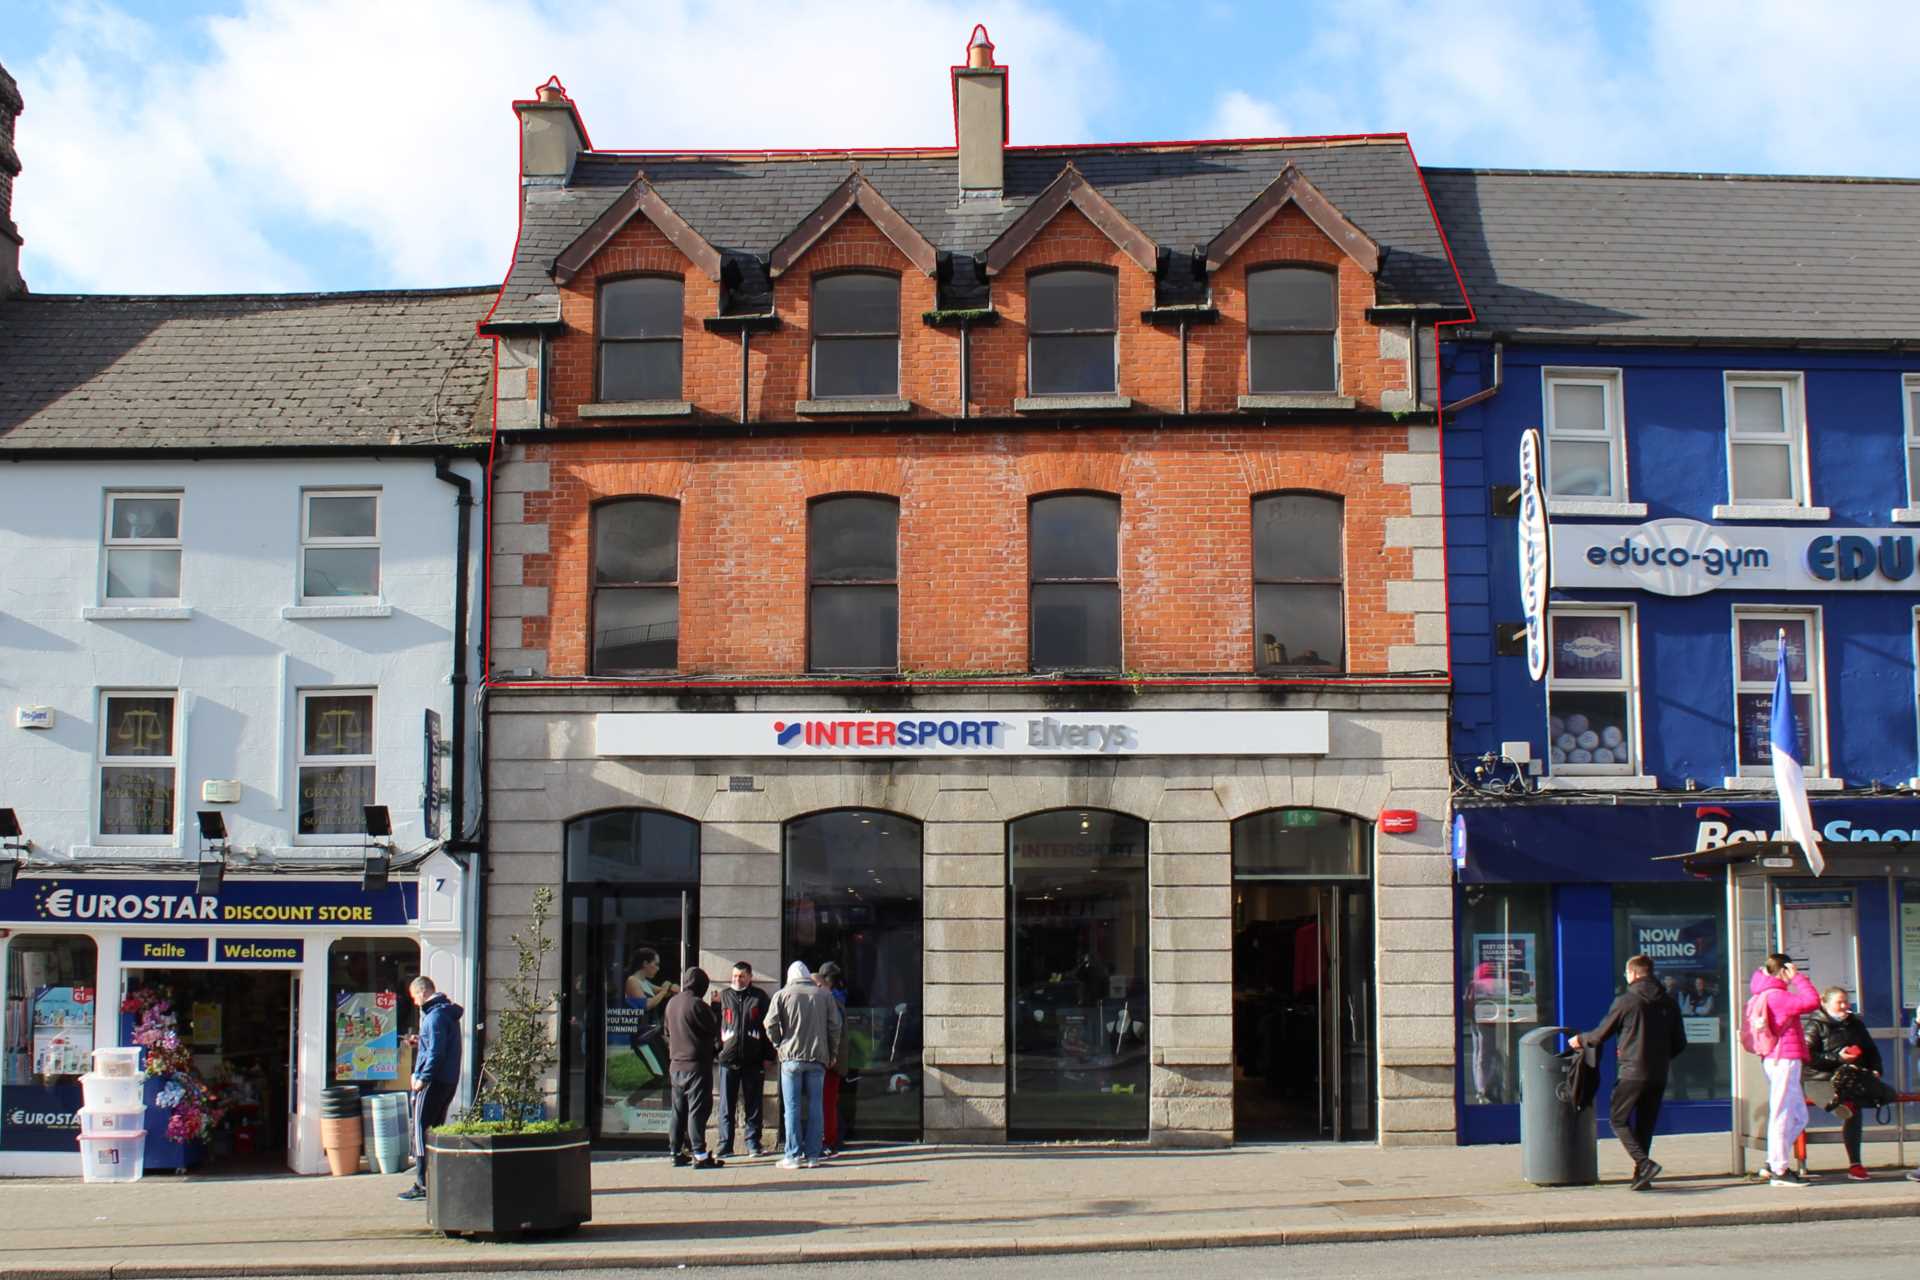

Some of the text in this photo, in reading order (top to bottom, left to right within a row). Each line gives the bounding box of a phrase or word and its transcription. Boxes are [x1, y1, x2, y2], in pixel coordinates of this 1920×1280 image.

[1587, 538, 1768, 576] educo-gym
[1807, 535, 1920, 582] EDU
[805, 721, 998, 746] INTERSPORT
[1027, 716, 1129, 752] Elverys
[435, 878, 446, 892] 7
[224, 906, 373, 921] DISCOUNT STORE
[1639, 929, 1680, 942] NOW
[143, 943, 297, 958] Failte Welcome
[1640, 943, 1697, 957] HIRING
[607, 1008, 644, 1016] WHEREVER
[621, 1017, 639, 1025] TAKE
[11, 1110, 82, 1125] €UROSTA
